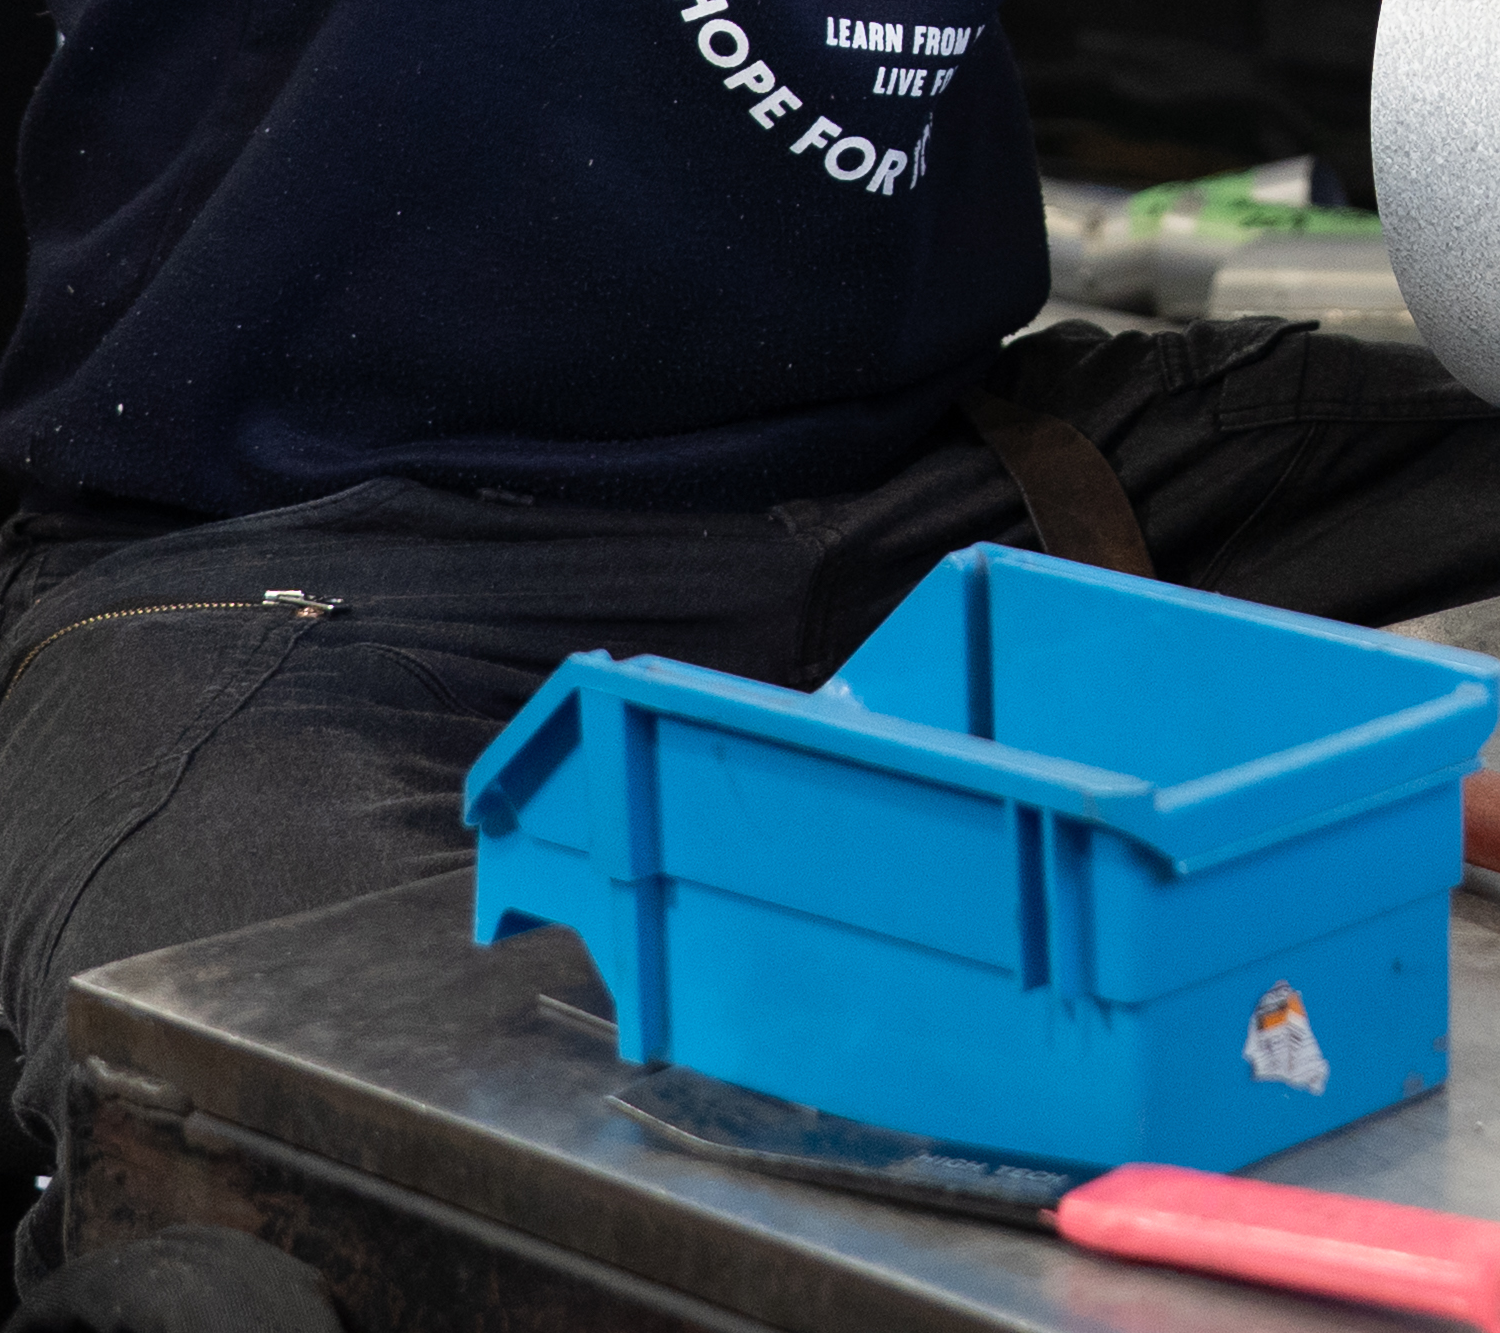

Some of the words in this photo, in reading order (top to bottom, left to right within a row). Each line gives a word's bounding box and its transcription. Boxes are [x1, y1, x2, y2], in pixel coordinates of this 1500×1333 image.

[825, 16, 904, 54] LEARN
[912, 25, 971, 56] FROM
[872, 66, 928, 98] LIVE
[789, 115, 908, 196] FOR
